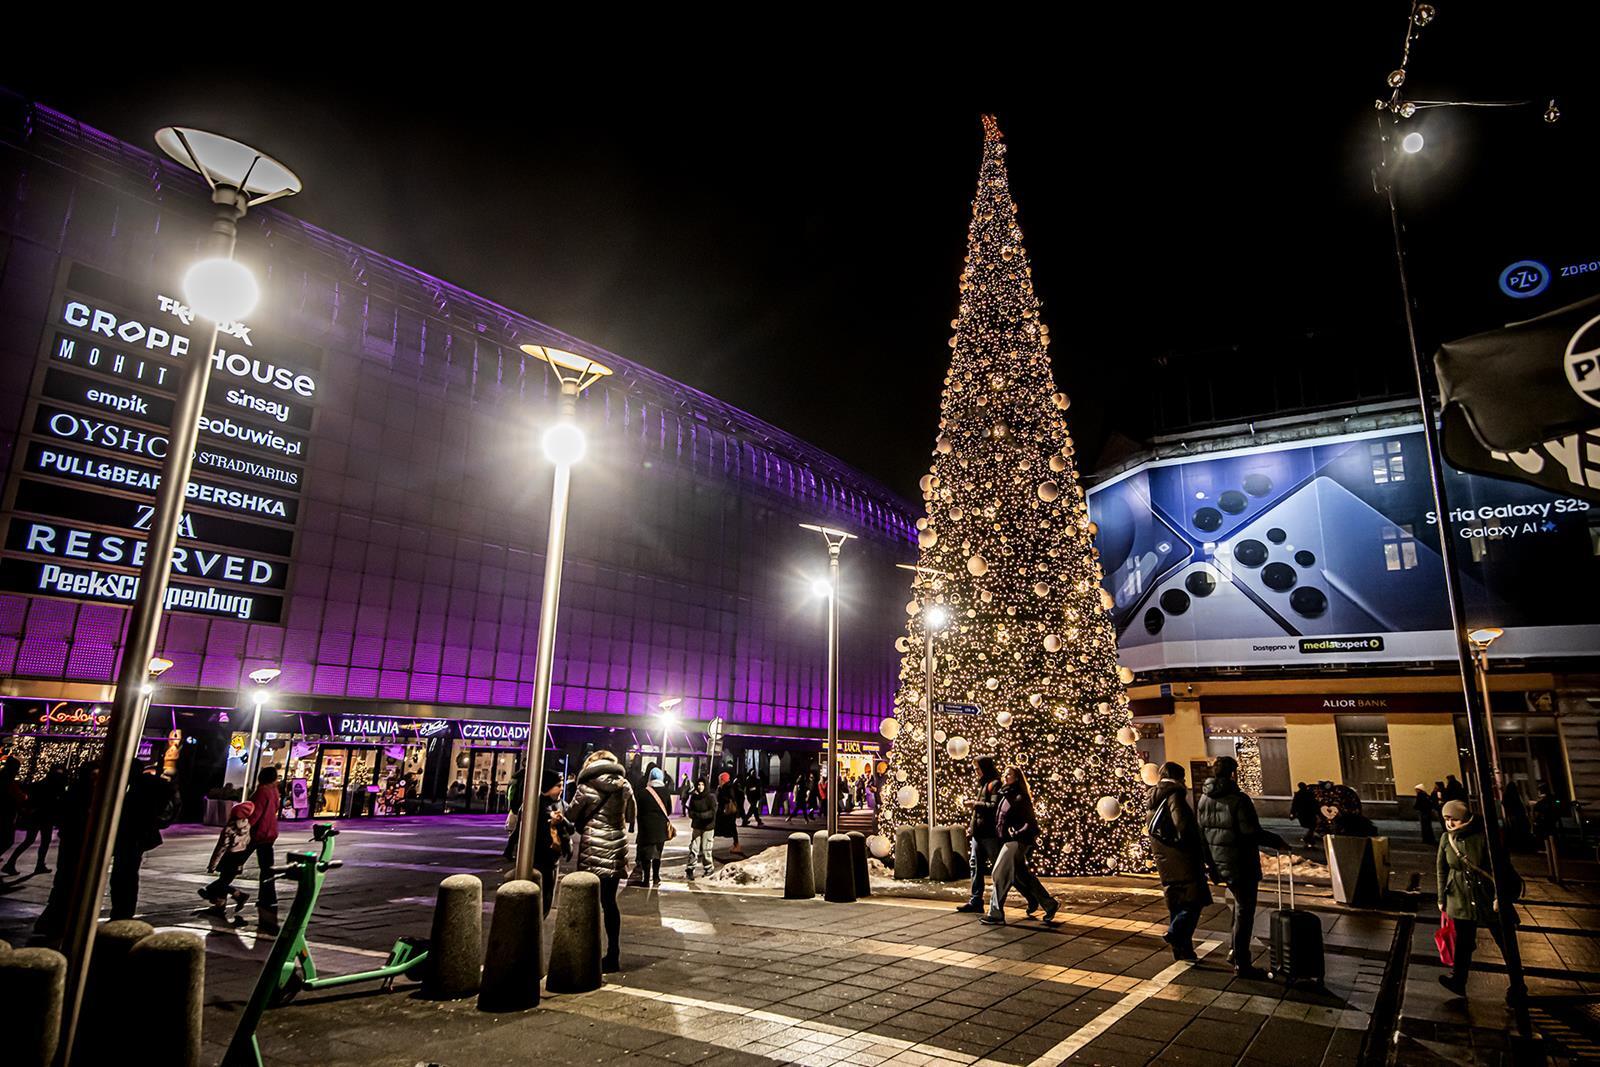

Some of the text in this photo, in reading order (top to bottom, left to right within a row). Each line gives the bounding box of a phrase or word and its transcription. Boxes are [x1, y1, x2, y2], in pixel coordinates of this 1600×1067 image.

[1510, 270, 1539, 289] PZU
[64, 301, 190, 357] CROPP
[58, 338, 169, 385] MOHIT
[87, 387, 148, 415] empik
[226, 388, 290, 423] sinsay
[197, 416, 301, 455] eobuwie.pl
[199, 451, 298, 485] STRADIVARIUS
[184, 482, 287, 518] BERSHKA
[1425, 498, 1590, 525] Sria Galaxy S25
[1459, 522, 1537, 539] Galaxy AI
[26, 523, 274, 585] RESERVED
[1323, 699, 1388, 708] ALIOR BANK
[341, 719, 400, 735] PIJALNIA
[463, 724, 531, 739] CZEKOLADY
